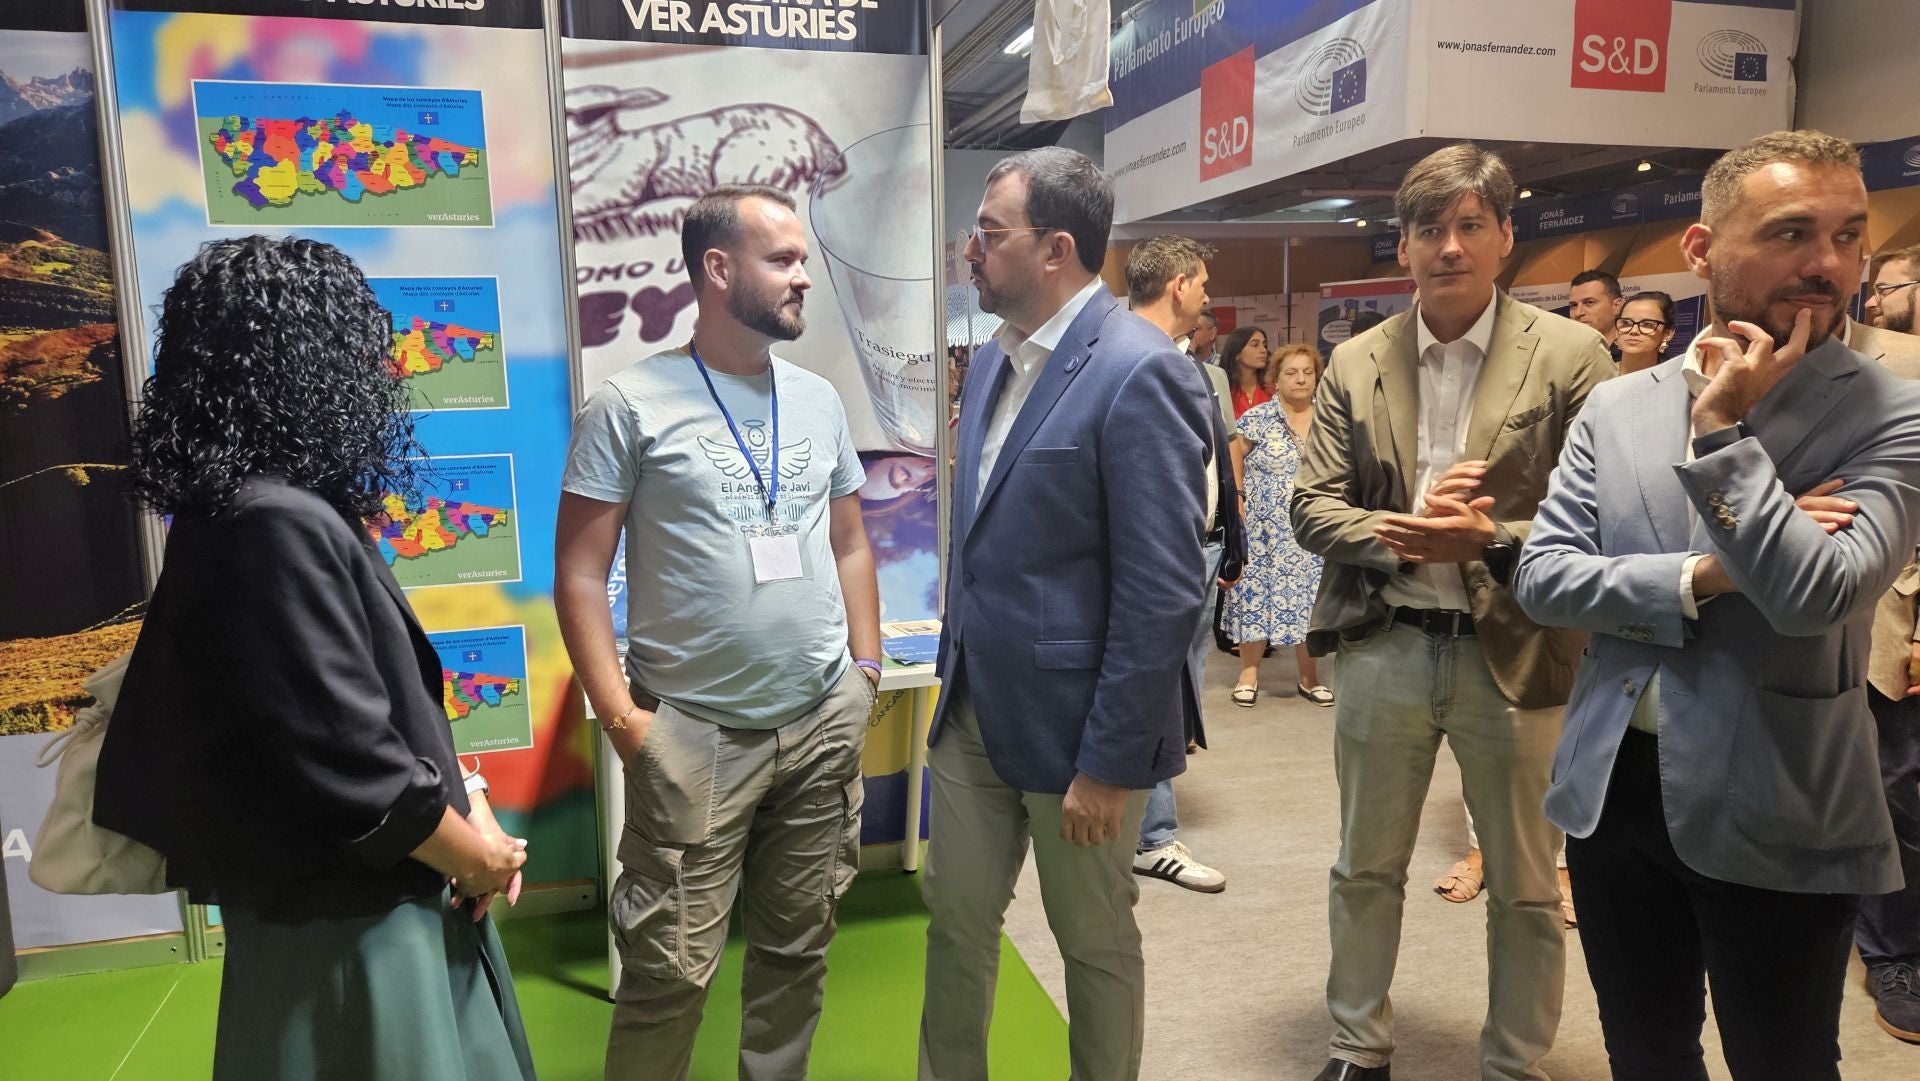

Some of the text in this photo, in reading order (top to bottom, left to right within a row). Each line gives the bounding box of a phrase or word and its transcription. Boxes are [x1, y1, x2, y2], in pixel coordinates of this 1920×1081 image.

[621, 0, 858, 40] VER ASTURIES
[1114, 0, 1225, 82] Parlamento Europeo
[1437, 39, 1556, 57] www.jonasfernandez.com
[1579, 34, 1659, 75] S&D
[1694, 82, 1767, 97] Parlamento Europeo
[1292, 113, 1366, 149] Parlamento Europeo
[1203, 115, 1249, 165] S&D
[427, 213, 480, 222] verAsturies
[1539, 208, 1565, 221] JONÁS
[1539, 214, 1585, 230] FERNÁNDEZ
[855, 328, 931, 365] Trasiegu
[443, 394, 495, 404] verAsturies
[721, 482, 732, 493] El
[790, 481, 811, 493] Javi
[457, 568, 508, 579] verAsturies
[470, 737, 520, 748] verAsturies
